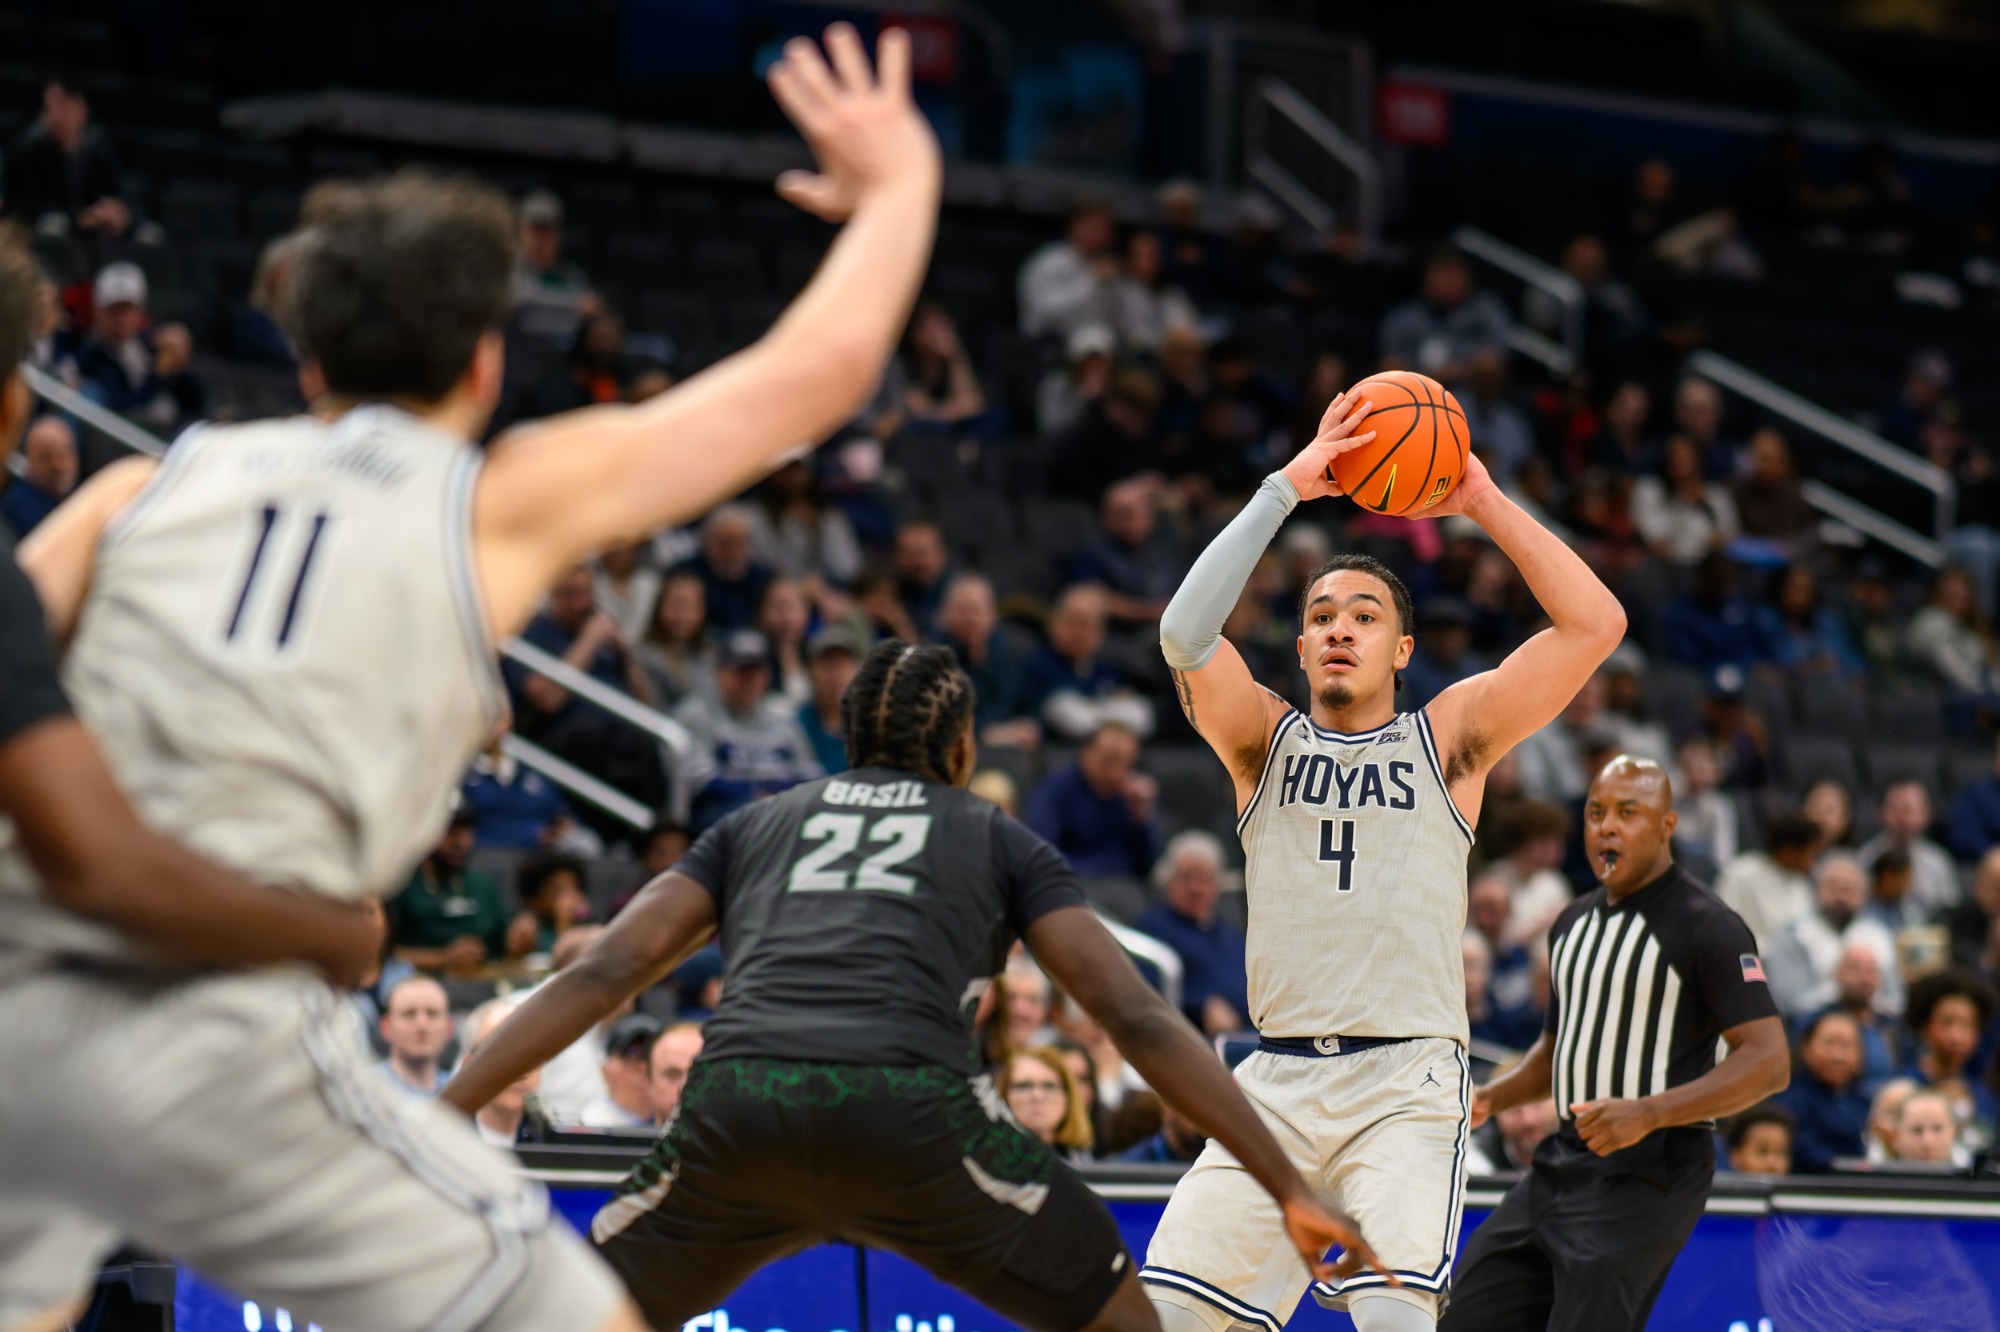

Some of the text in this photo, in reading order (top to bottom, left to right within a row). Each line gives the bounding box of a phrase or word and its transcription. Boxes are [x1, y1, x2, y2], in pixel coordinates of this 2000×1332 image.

[226, 502, 330, 650] 11
[1376, 736, 1408, 746] EAST
[1380, 731, 1402, 739] BIG
[821, 779, 929, 809] BASIL
[1278, 753, 1416, 812] HOYAS
[786, 811, 933, 897] 22
[1317, 818, 1357, 893] 4
